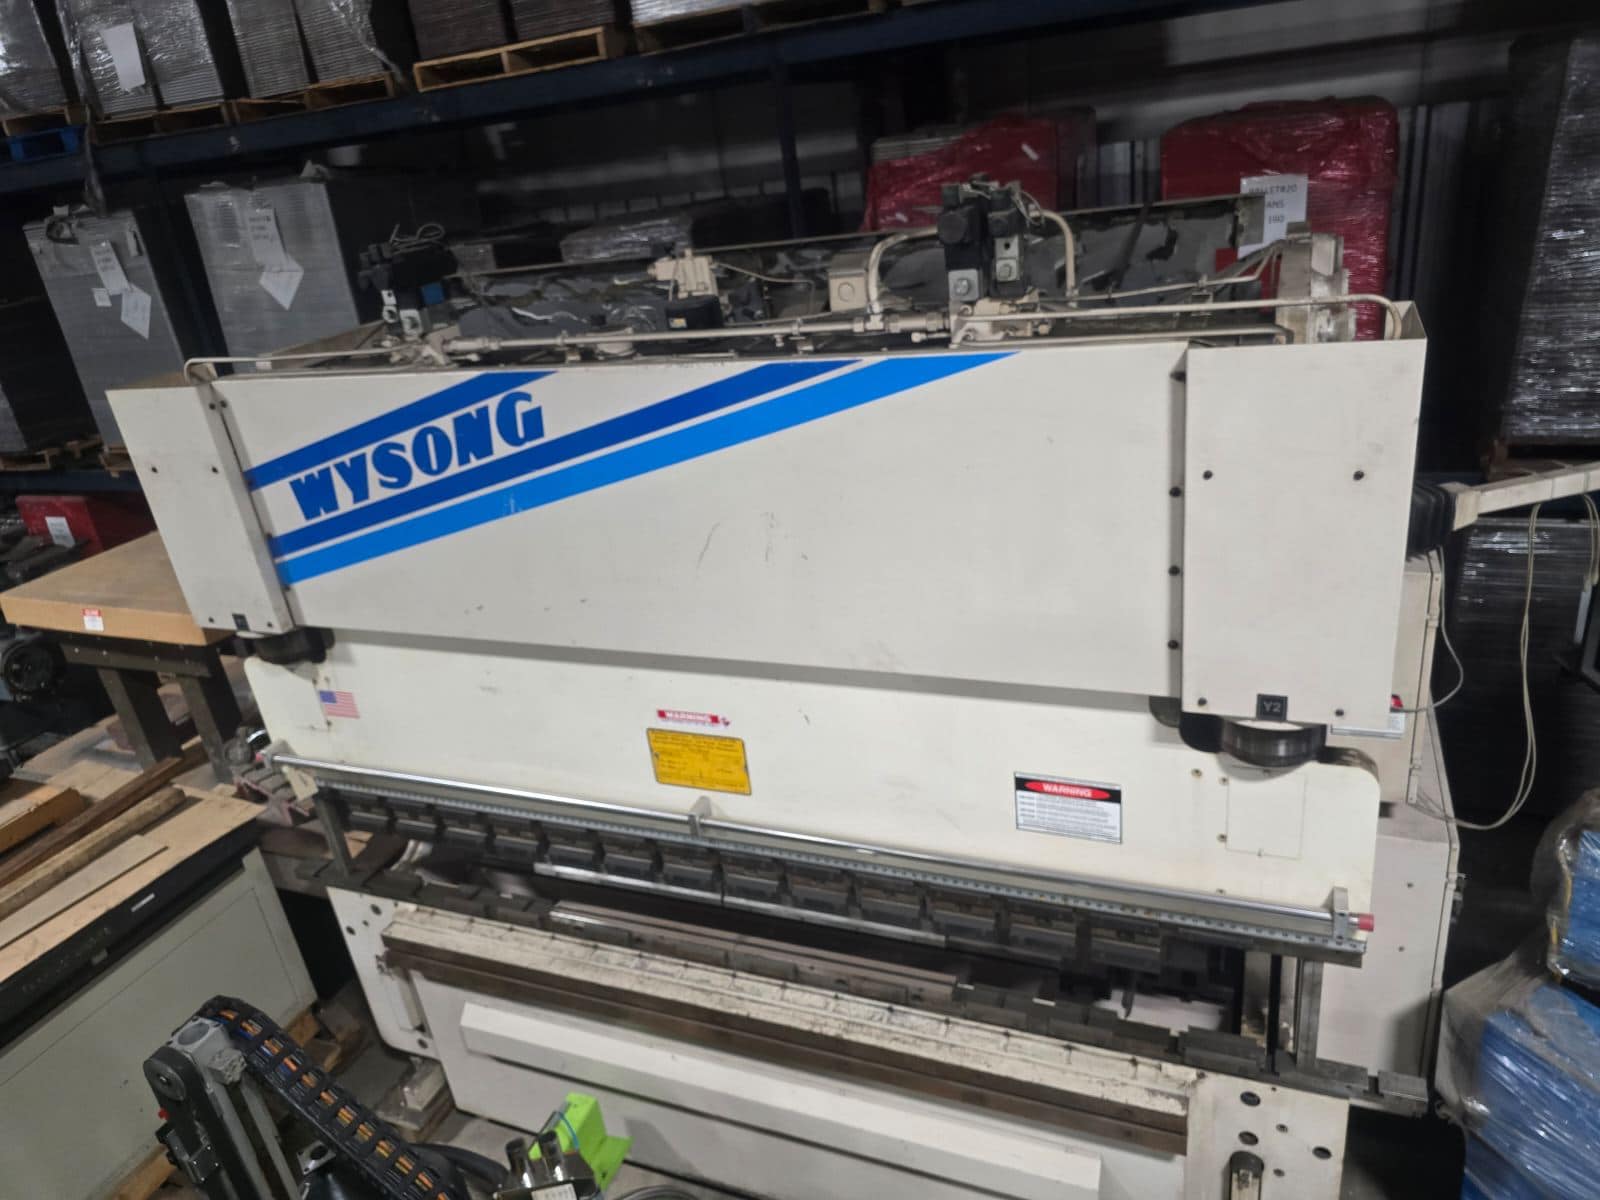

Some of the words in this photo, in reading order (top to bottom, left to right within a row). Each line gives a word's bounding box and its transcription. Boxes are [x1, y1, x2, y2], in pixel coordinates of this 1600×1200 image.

[289, 391, 544, 521] WYSONG
[1263, 701, 1281, 712] Y2
[1041, 783, 1093, 799] WARNING
